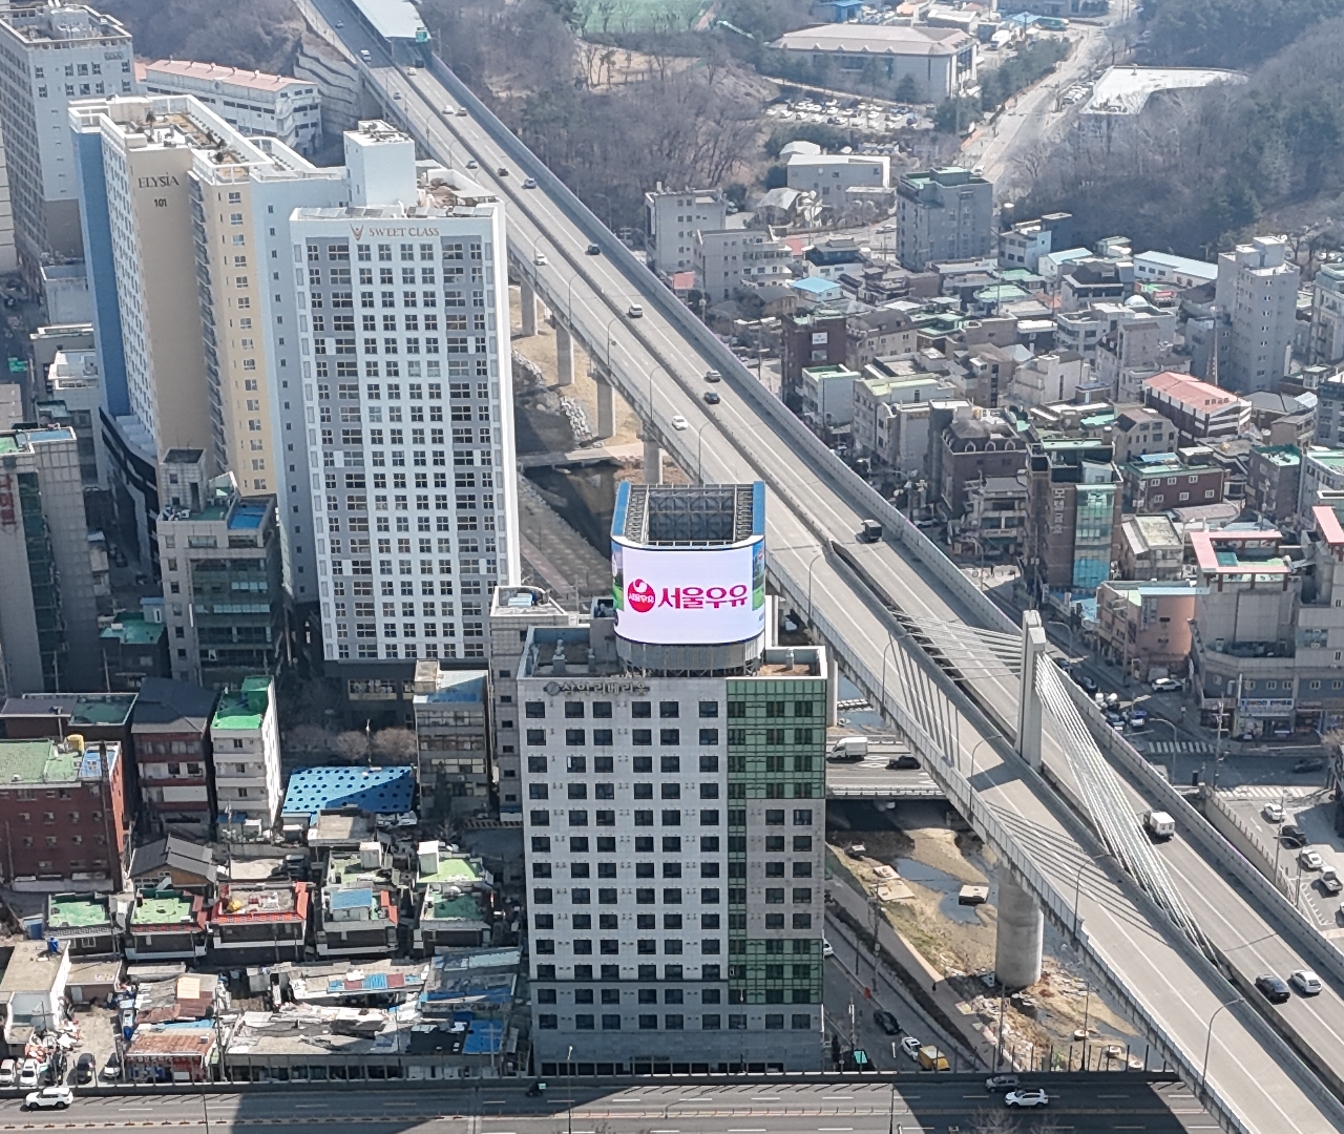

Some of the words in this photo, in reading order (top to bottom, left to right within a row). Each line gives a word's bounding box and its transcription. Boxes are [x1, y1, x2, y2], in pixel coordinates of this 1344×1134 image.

[154, 198, 167, 207] 101
[369, 227, 406, 237] SWEET
[408, 227, 440, 237] CLASS
[657, 584, 748, 609] 서울우유
